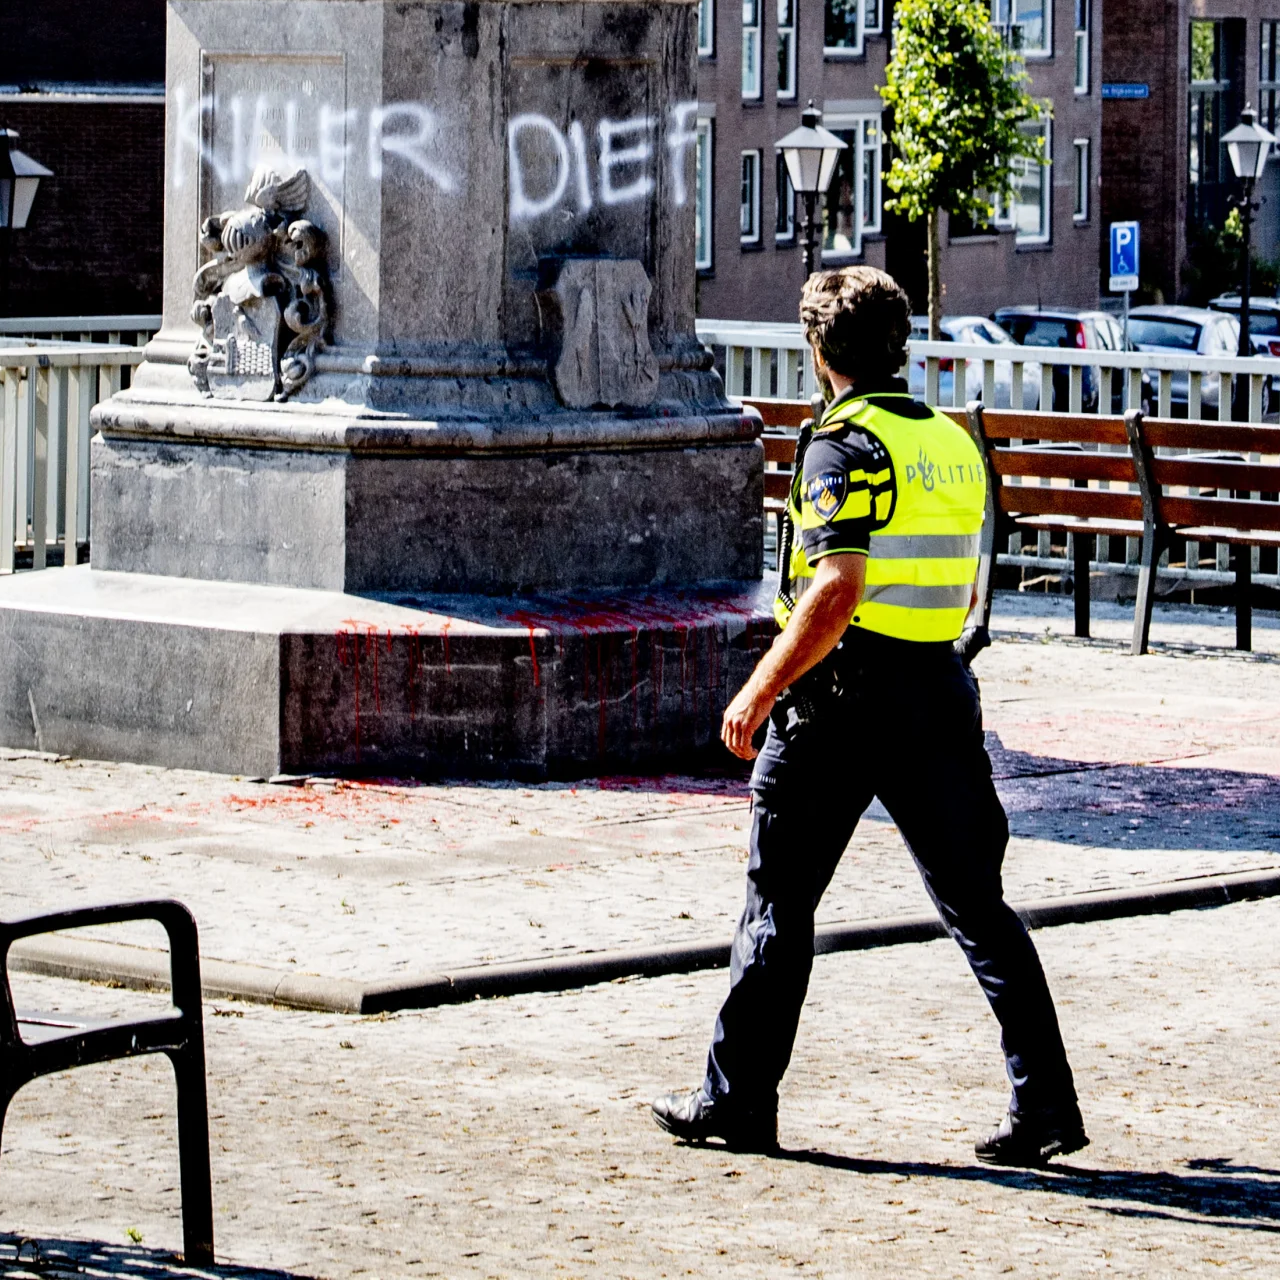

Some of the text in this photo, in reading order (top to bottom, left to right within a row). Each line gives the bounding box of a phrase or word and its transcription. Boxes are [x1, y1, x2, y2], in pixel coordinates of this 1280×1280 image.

[171, 86, 461, 192] KILLER
[506, 100, 699, 217] DIEF
[1116, 228, 1132, 255] P
